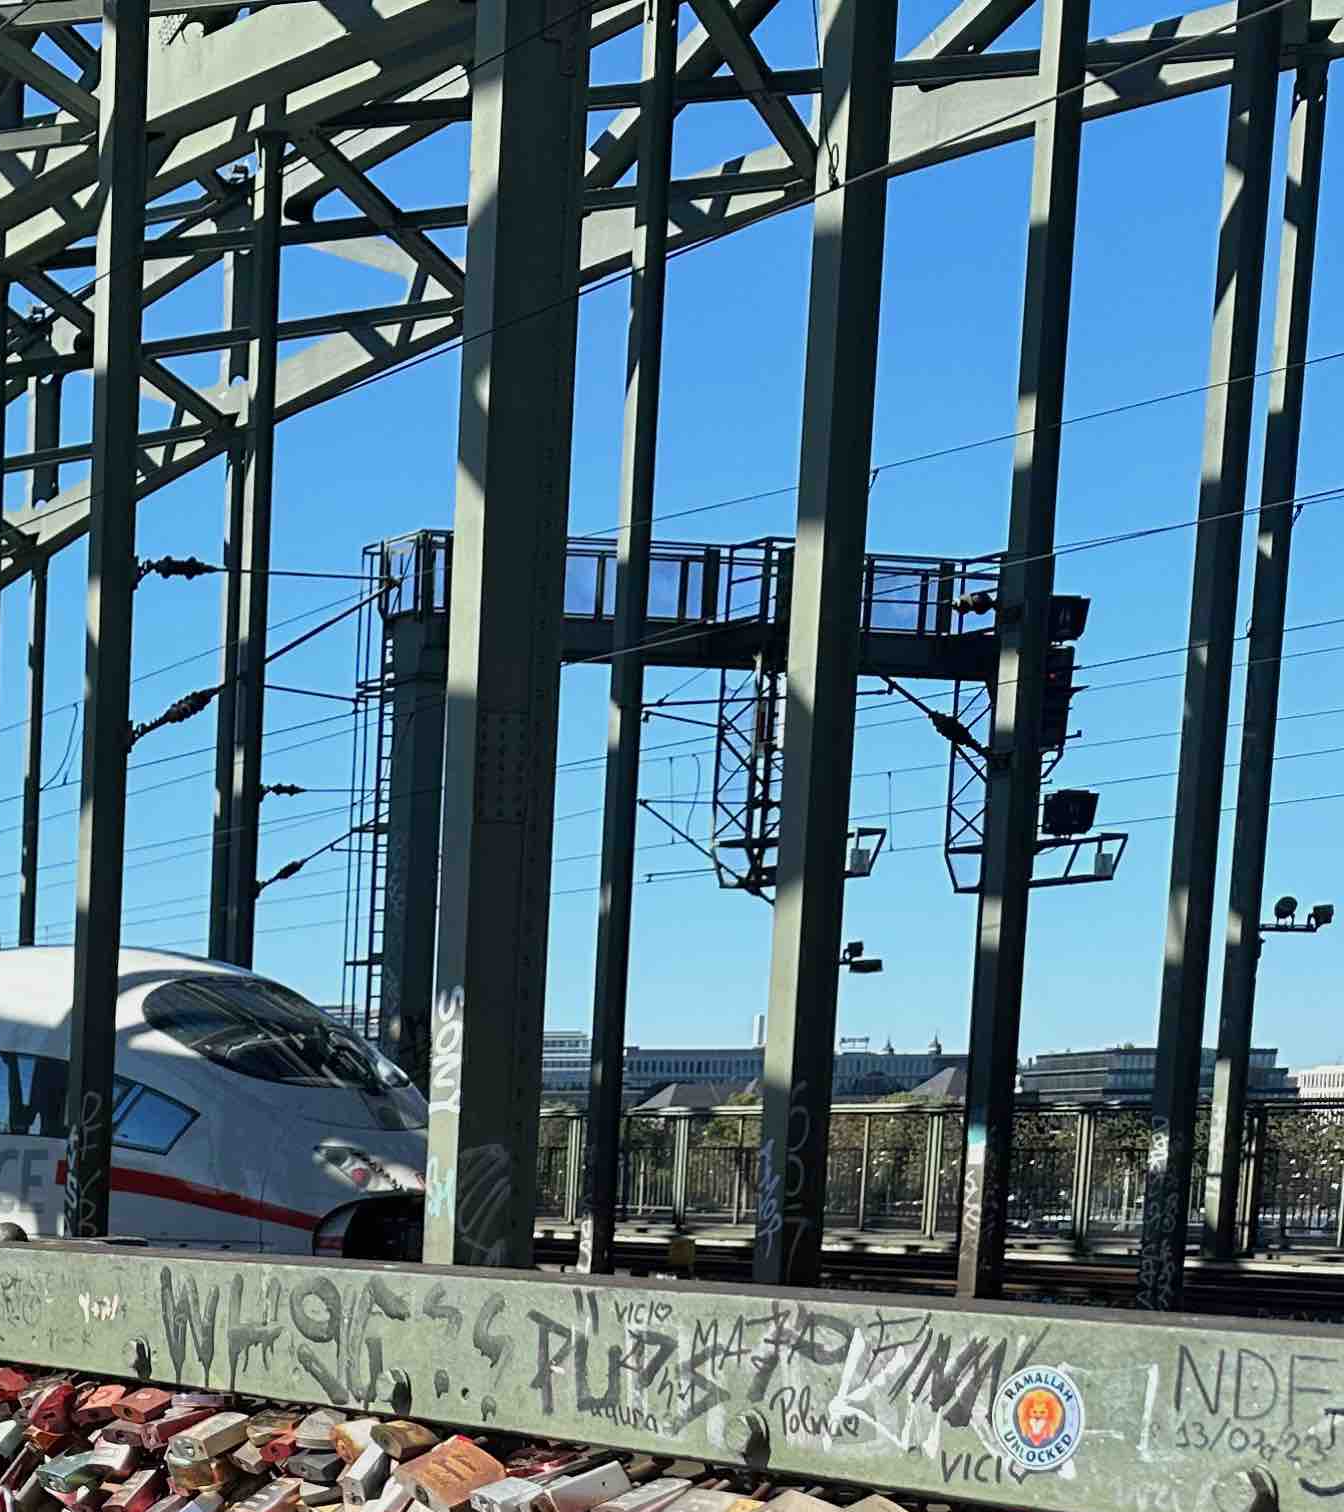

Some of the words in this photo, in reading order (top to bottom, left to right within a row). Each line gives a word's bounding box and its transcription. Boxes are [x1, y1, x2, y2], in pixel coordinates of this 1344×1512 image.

[430, 984, 465, 1115] SONY
[1004, 1372, 1073, 1402] RAMALLAH
[1004, 1432, 1073, 1463] UNLOCKED
[940, 1451, 1003, 1485] VICI
